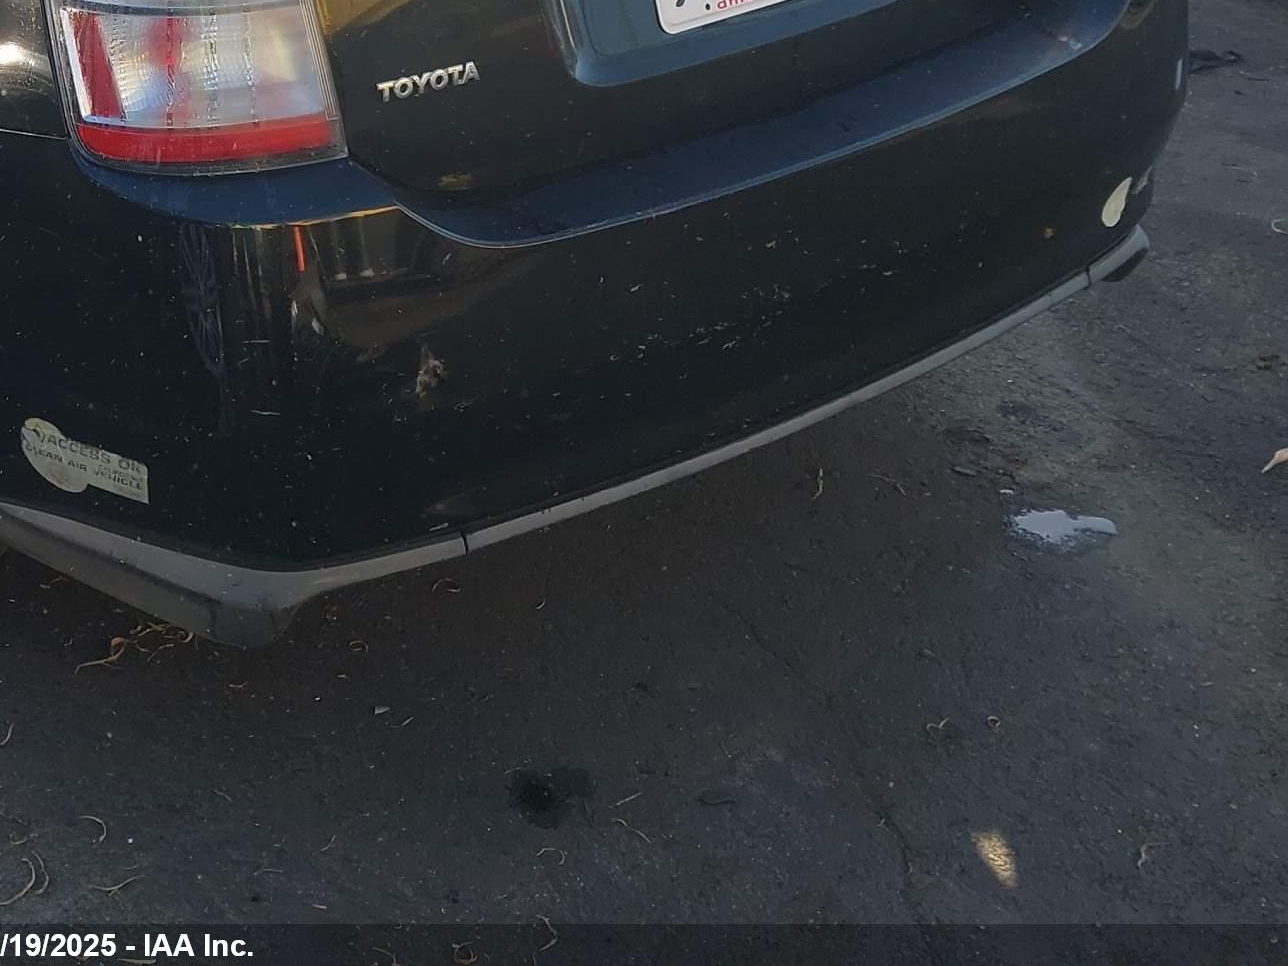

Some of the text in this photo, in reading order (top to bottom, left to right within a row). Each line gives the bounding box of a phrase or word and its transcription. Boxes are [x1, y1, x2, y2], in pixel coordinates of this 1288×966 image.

[376, 61, 480, 102] TOYOTA
[25, 444, 64, 463] CLEAN
[68, 459, 88, 472] AIR
[47, 436, 111, 465] ACCESS
